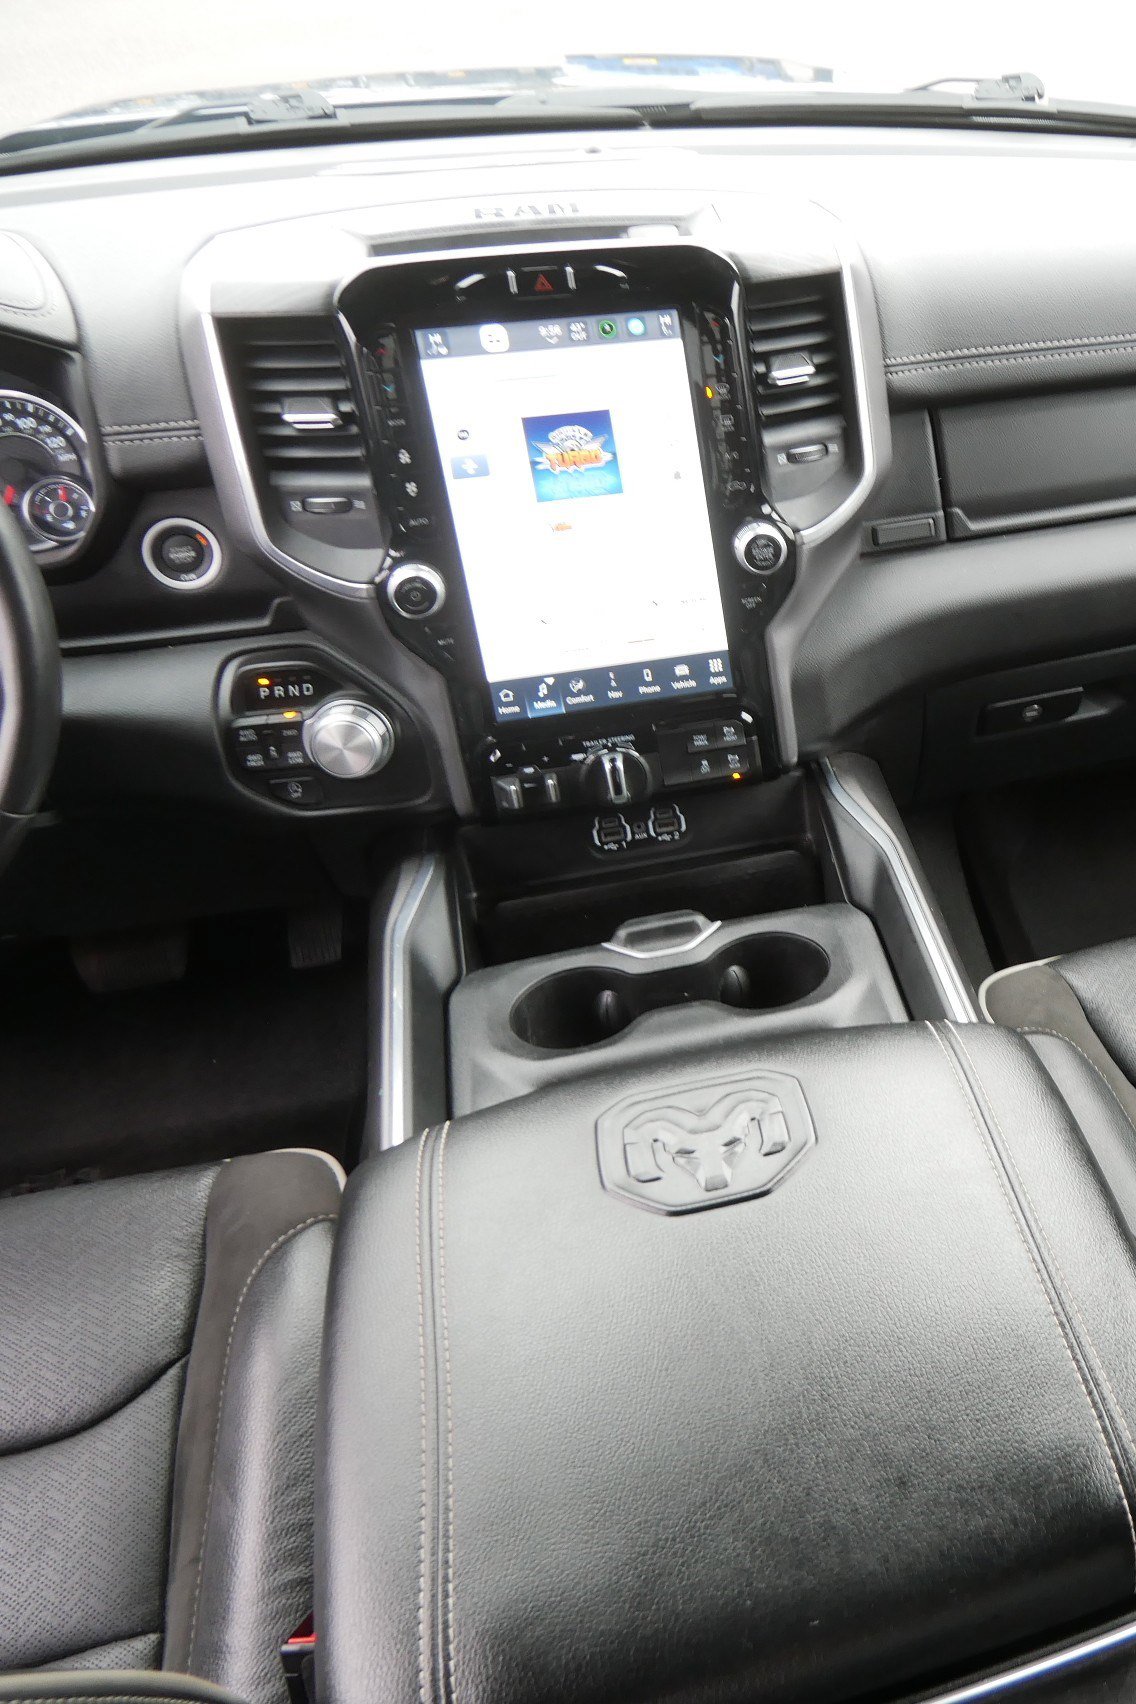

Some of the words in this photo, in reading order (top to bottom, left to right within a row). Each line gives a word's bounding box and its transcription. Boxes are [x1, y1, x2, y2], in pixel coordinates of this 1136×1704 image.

[671, 679, 698, 690] Vehicle
[709, 674, 728, 686] Apps
[608, 689, 623, 699] Nav
[638, 684, 661, 695] Phone
[533, 699, 557, 710] Media
[566, 693, 595, 705] Comfort
[498, 704, 521, 715] Home
